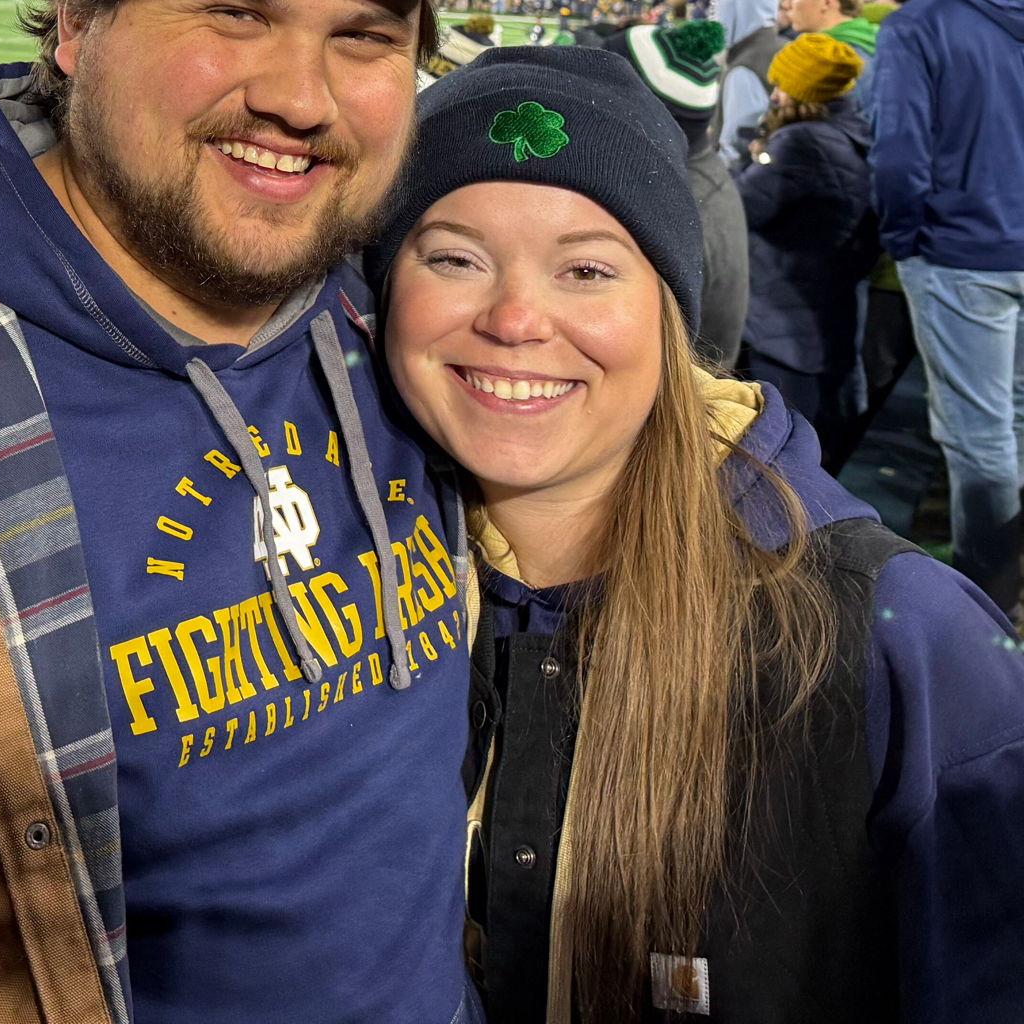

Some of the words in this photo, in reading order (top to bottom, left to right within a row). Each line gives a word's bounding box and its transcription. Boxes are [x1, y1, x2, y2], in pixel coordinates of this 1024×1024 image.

[284, 420, 407, 503] DAE
[109, 572, 363, 736] FIGHTING
[357, 514, 457, 640] IRSH
[178, 652, 384, 768] ESTABLISHED
